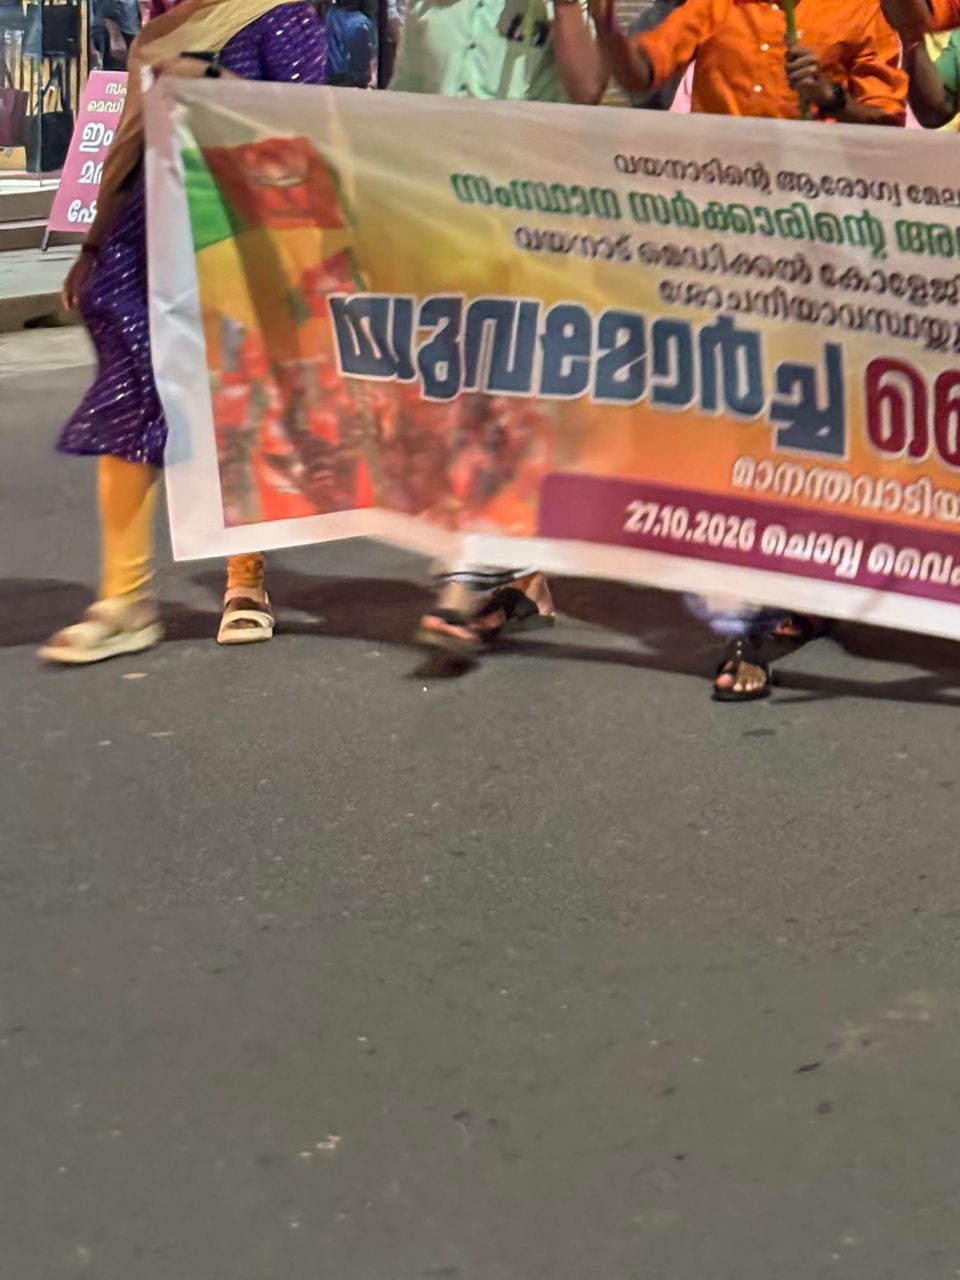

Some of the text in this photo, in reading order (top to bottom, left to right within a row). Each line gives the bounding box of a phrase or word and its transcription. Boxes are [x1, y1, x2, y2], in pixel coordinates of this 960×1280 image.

[450, 173, 621, 220] സംസ്ഥാന
[776, 169, 901, 207] ആരോഗ്യ
[514, 225, 633, 263] വയനാട്
[638, 239, 813, 287] മെഡിക്കൽ
[330, 293, 849, 459] യുവമോർച്ച
[623, 500, 757, 553] 27.10.2026
[760, 525, 864, 579] ചൊവ്വ
